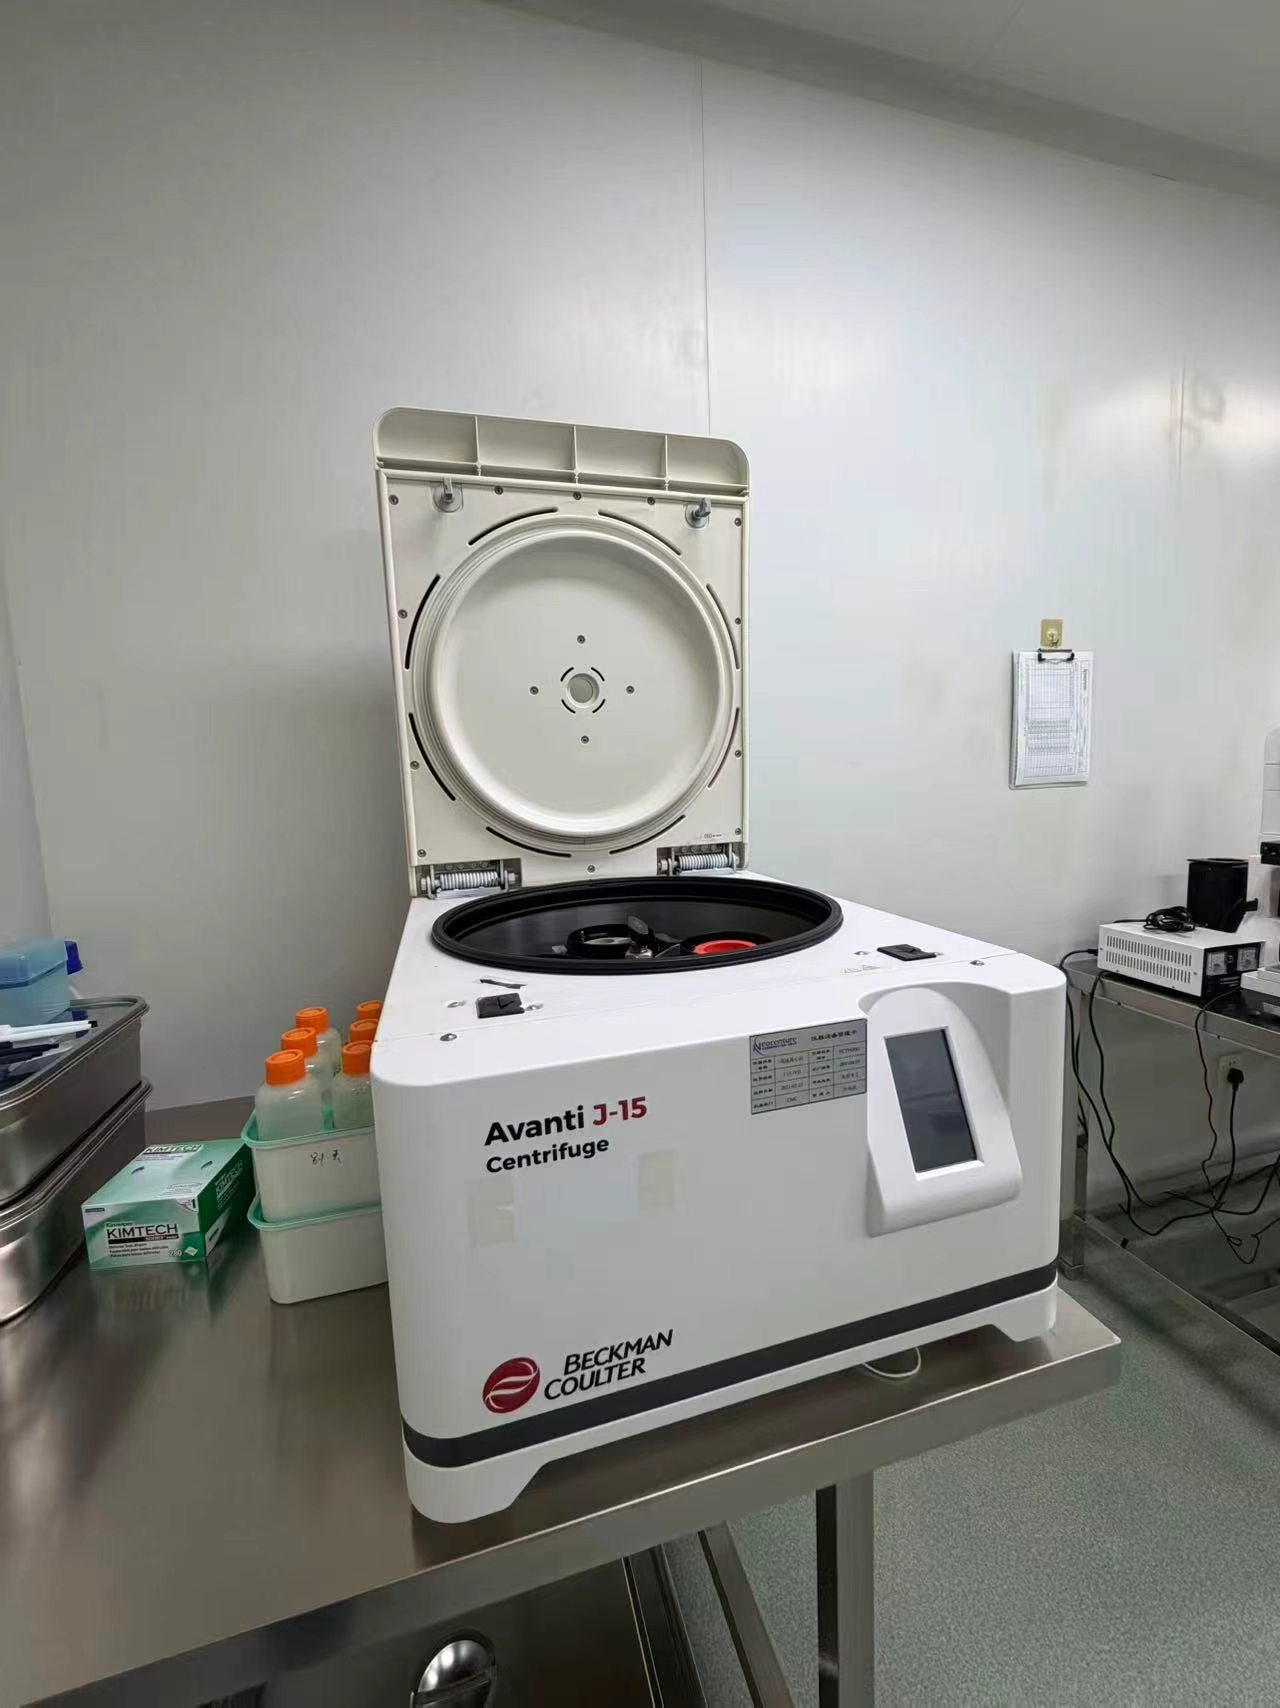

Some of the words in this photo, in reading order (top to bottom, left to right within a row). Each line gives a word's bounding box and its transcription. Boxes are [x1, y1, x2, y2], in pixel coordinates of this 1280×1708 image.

[484, 1105, 585, 1146] Avanti
[592, 1096, 648, 1126] J-15
[486, 1139, 609, 1173] Centrifuge
[106, 1223, 178, 1239] KIMTECH
[563, 1329, 674, 1376] BECKMAN
[544, 1357, 646, 1400] COULTER
